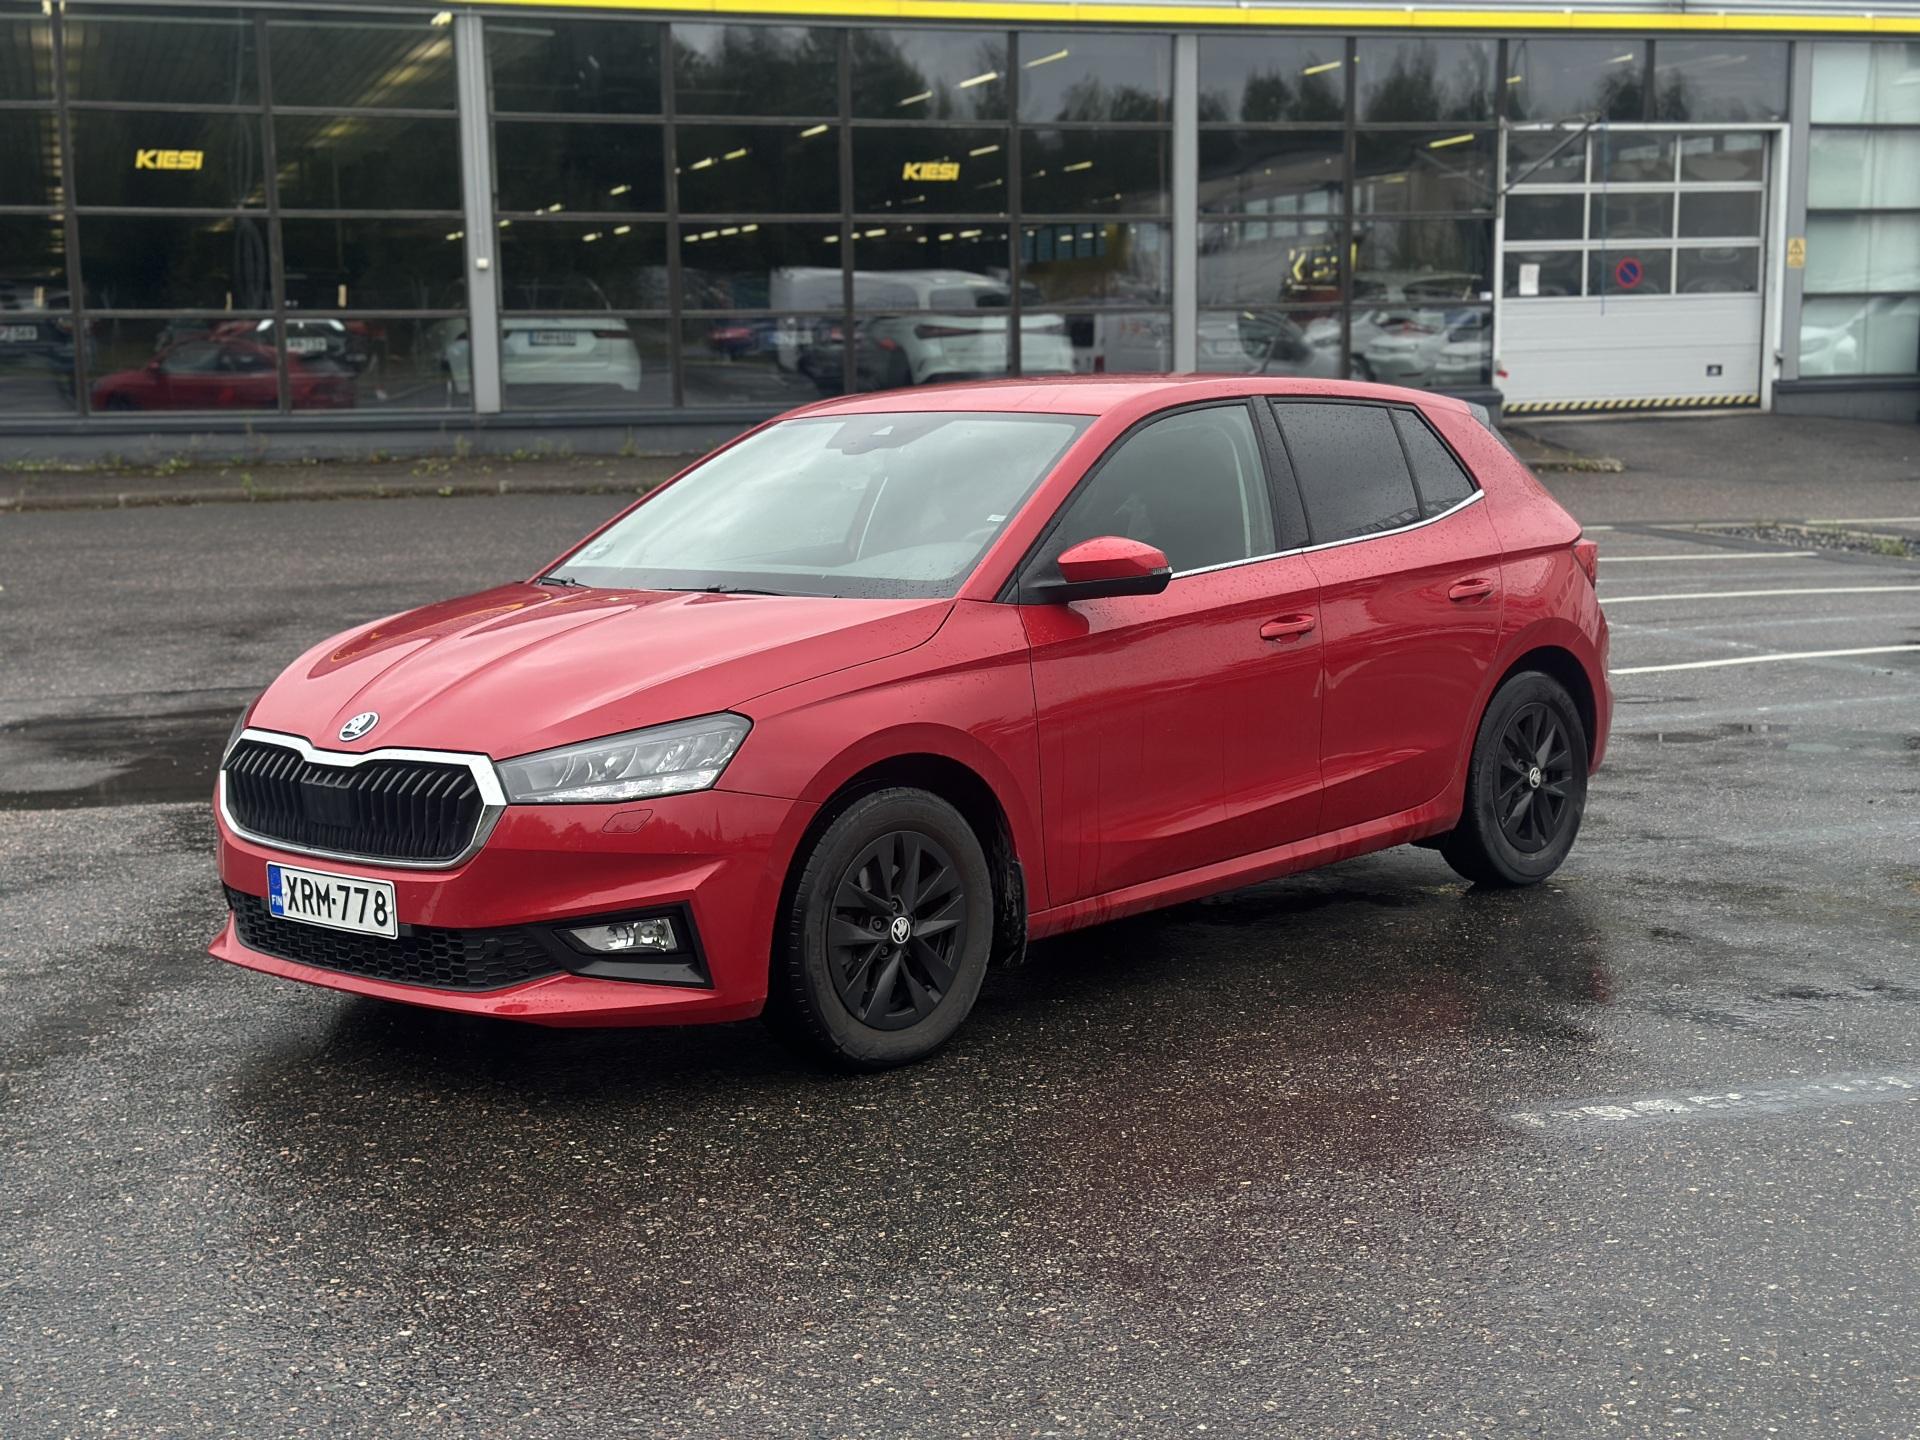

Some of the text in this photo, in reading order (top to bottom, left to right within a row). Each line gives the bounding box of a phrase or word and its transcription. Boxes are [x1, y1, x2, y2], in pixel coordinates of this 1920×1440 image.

[135, 149, 204, 170] KIESI
[902, 162, 960, 181] KIESI
[272, 894, 283, 907] FIN
[285, 874, 388, 927] XRM-778
